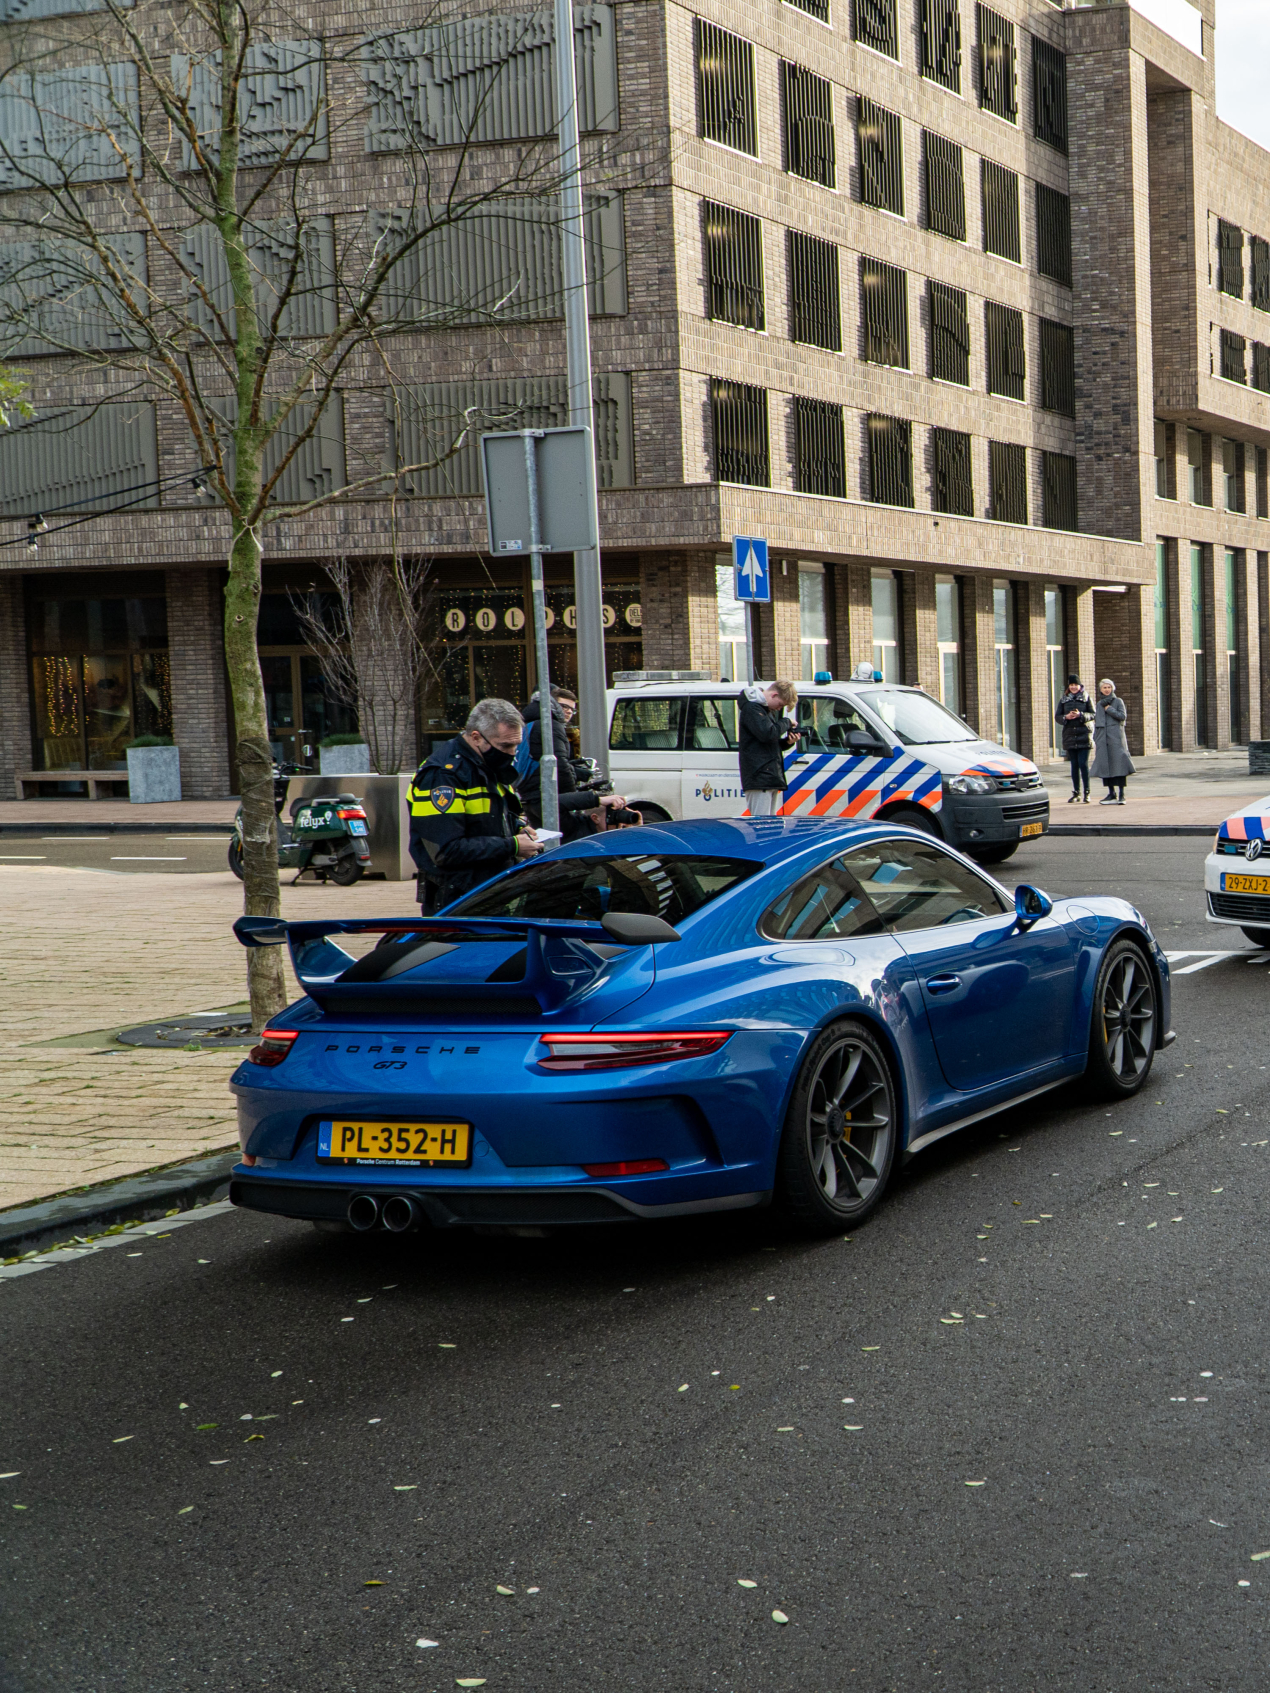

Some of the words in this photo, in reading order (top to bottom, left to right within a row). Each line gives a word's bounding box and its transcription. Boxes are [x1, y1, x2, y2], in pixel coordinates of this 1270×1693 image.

[1228, 876, 1269, 892] 29-ZXJ-2
[324, 1044, 481, 1055] PORSCHE
[372, 1060, 408, 1070] GT3
[340, 1126, 458, 1155] PL-352-H
[320, 1142, 330, 1151] NL
